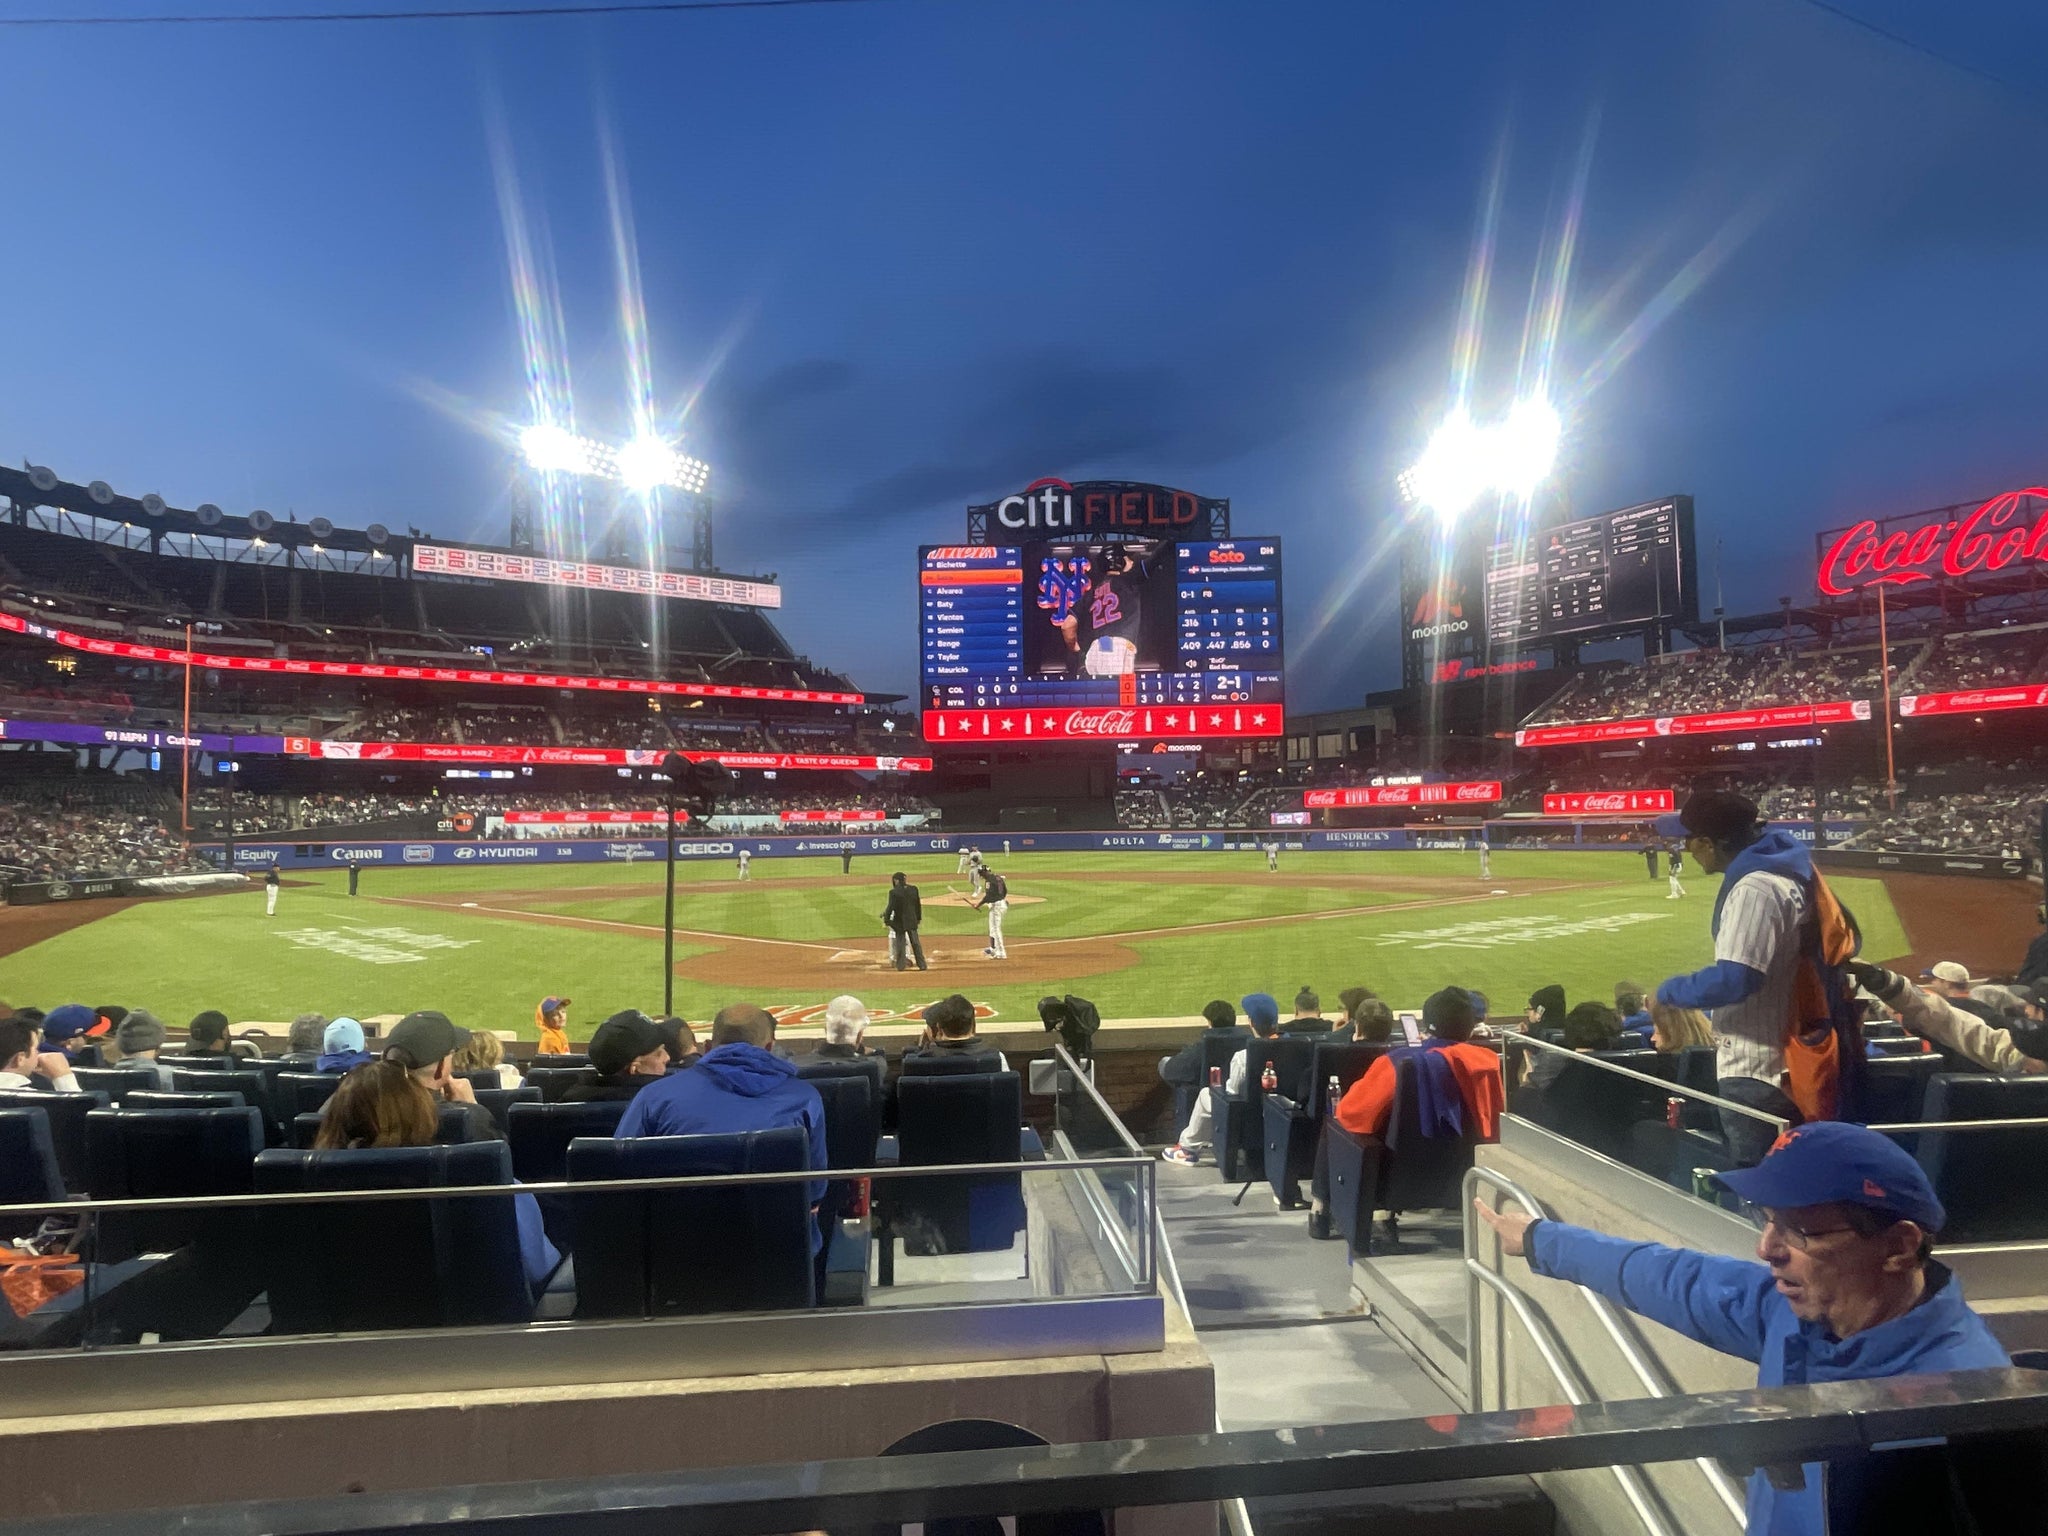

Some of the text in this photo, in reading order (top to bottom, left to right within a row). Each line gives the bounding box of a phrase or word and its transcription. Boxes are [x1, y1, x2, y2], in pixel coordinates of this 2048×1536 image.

[998, 486, 1199, 528] citi FIELD
[1218, 542, 1234, 550] Juan
[1818, 486, 2048, 597] Coca-Col
[1179, 547, 1274, 563] 22 Soto DH
[937, 560, 967, 568] Bichette
[937, 587, 964, 595] Alvarez
[1181, 591, 1195, 599] 0-1
[937, 600, 954, 608] Baty
[1090, 592, 1122, 629] 22
[937, 613, 965, 622] Vientos
[1182, 618, 1199, 627] .316
[1237, 618, 1243, 626] 5
[1263, 617, 1268, 625] 3
[937, 627, 965, 635] Semien
[1412, 620, 1468, 640] moomoo
[937, 640, 961, 650] Benge
[1181, 640, 1268, 651] .409 .447 .856 0
[938, 653, 960, 663] Taylor
[938, 665, 969, 674] Mauricio
[1464, 660, 1537, 678] new balance
[1176, 681, 1183, 690] 4
[1193, 681, 1200, 689] 2
[1217, 676, 1241, 690] 2-1
[977, 685, 984, 694] 0
[994, 684, 1000, 694] 0
[1010, 683, 1017, 693] 0
[977, 697, 984, 706] 0
[1141, 695, 1147, 703] 3
[1156, 694, 1163, 702] 0
[1177, 694, 1183, 702] 4
[1193, 693, 1200, 702] 2
[1064, 709, 1137, 736] Coca-Cola
[120, 735, 147, 743] MPH
[292, 741, 302, 750] 5
[1168, 744, 1202, 752] moomoo
[541, 748, 606, 761] Coca-Cola CORNER
[720, 756, 776, 765] QUEENSBORO
[795, 756, 859, 766] TASTE OF QUEENS
[1377, 788, 1409, 803] Coca-Cola
[1456, 783, 1492, 800] Coca-Cola
[1307, 791, 1337, 806] Coca-Cola
[1583, 794, 1626, 811] Coca-Cola
[437, 819, 453, 828] citi
[1112, 837, 1145, 846] DELTA
[1326, 832, 1389, 842] HENDRICK'S
[809, 842, 840, 851] Invesco
[880, 840, 916, 850] Guardian
[931, 837, 949, 849] citi
[479, 847, 538, 858] HYUNDAI
[680, 842, 734, 856] GEICO
[332, 849, 384, 860] Canon
